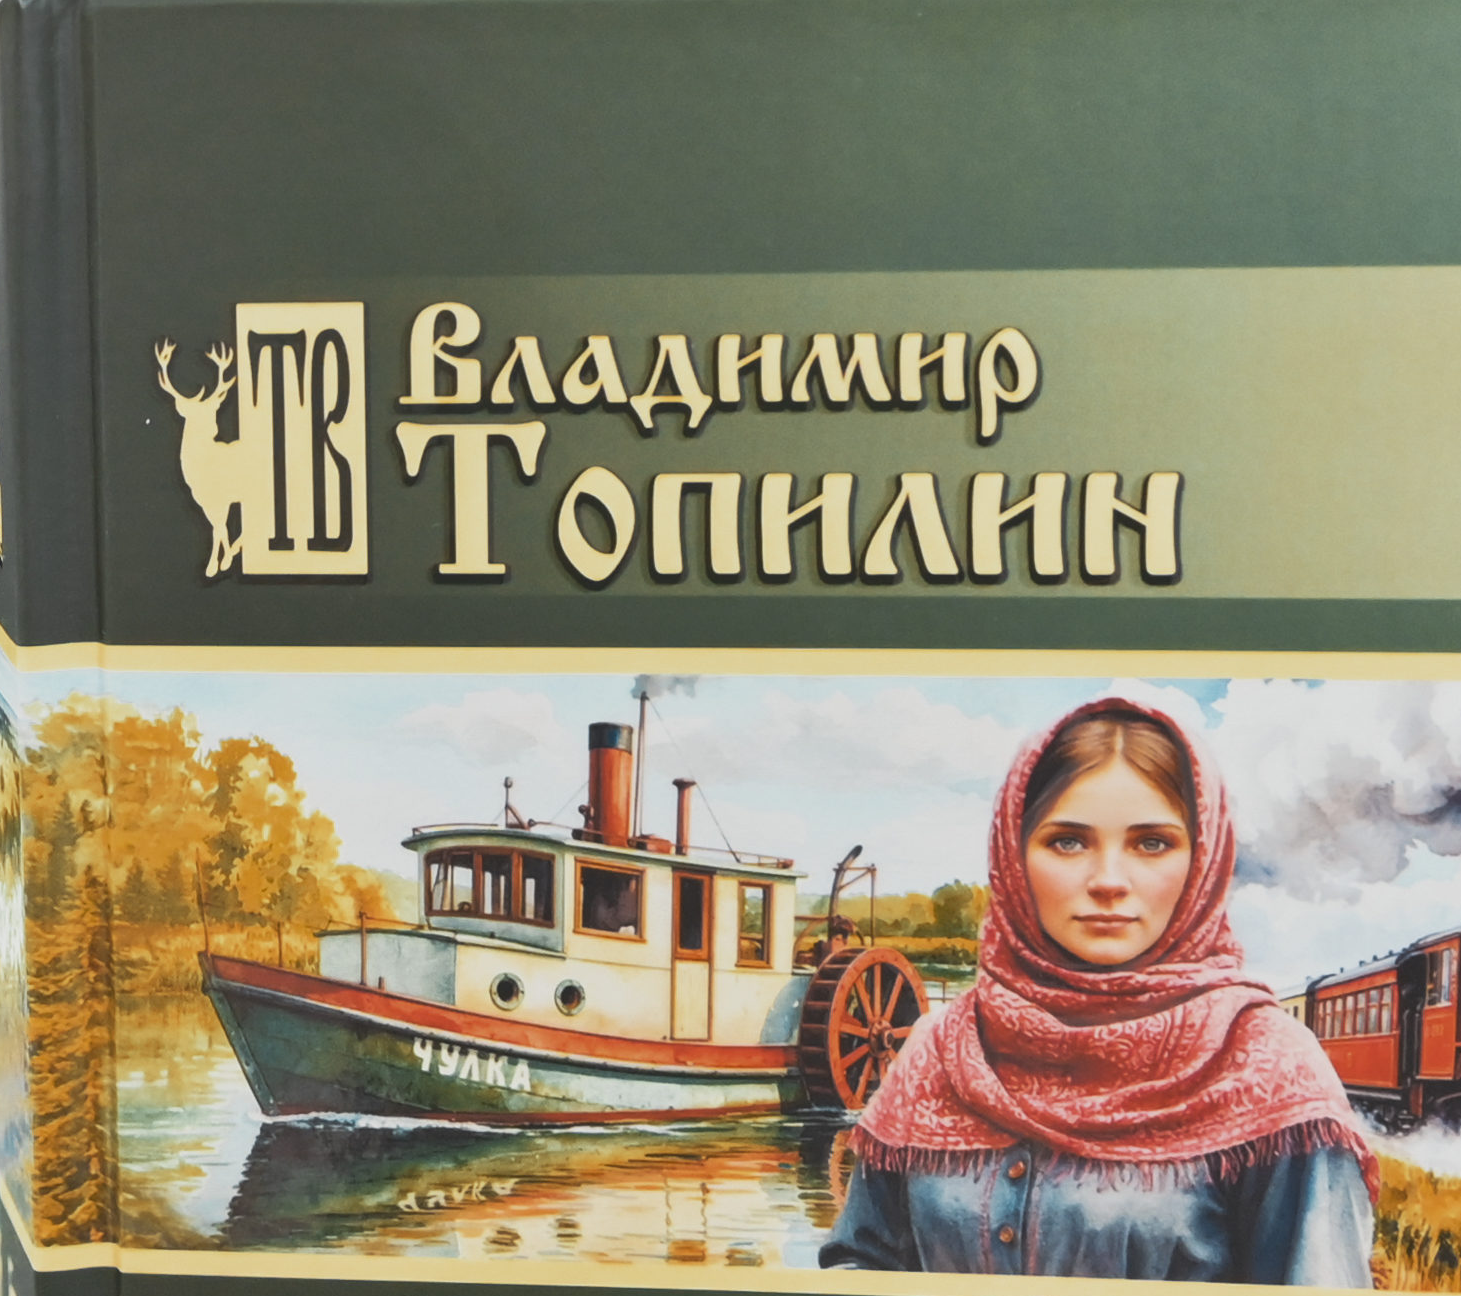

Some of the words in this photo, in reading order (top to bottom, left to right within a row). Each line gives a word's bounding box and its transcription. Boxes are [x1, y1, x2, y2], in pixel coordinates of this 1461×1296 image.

[247, 327, 353, 555] ТВ
[398, 301, 1041, 441] Владимир
[394, 420, 1184, 583] Топилин
[412, 1036, 532, 1093] ЧУЛКА
